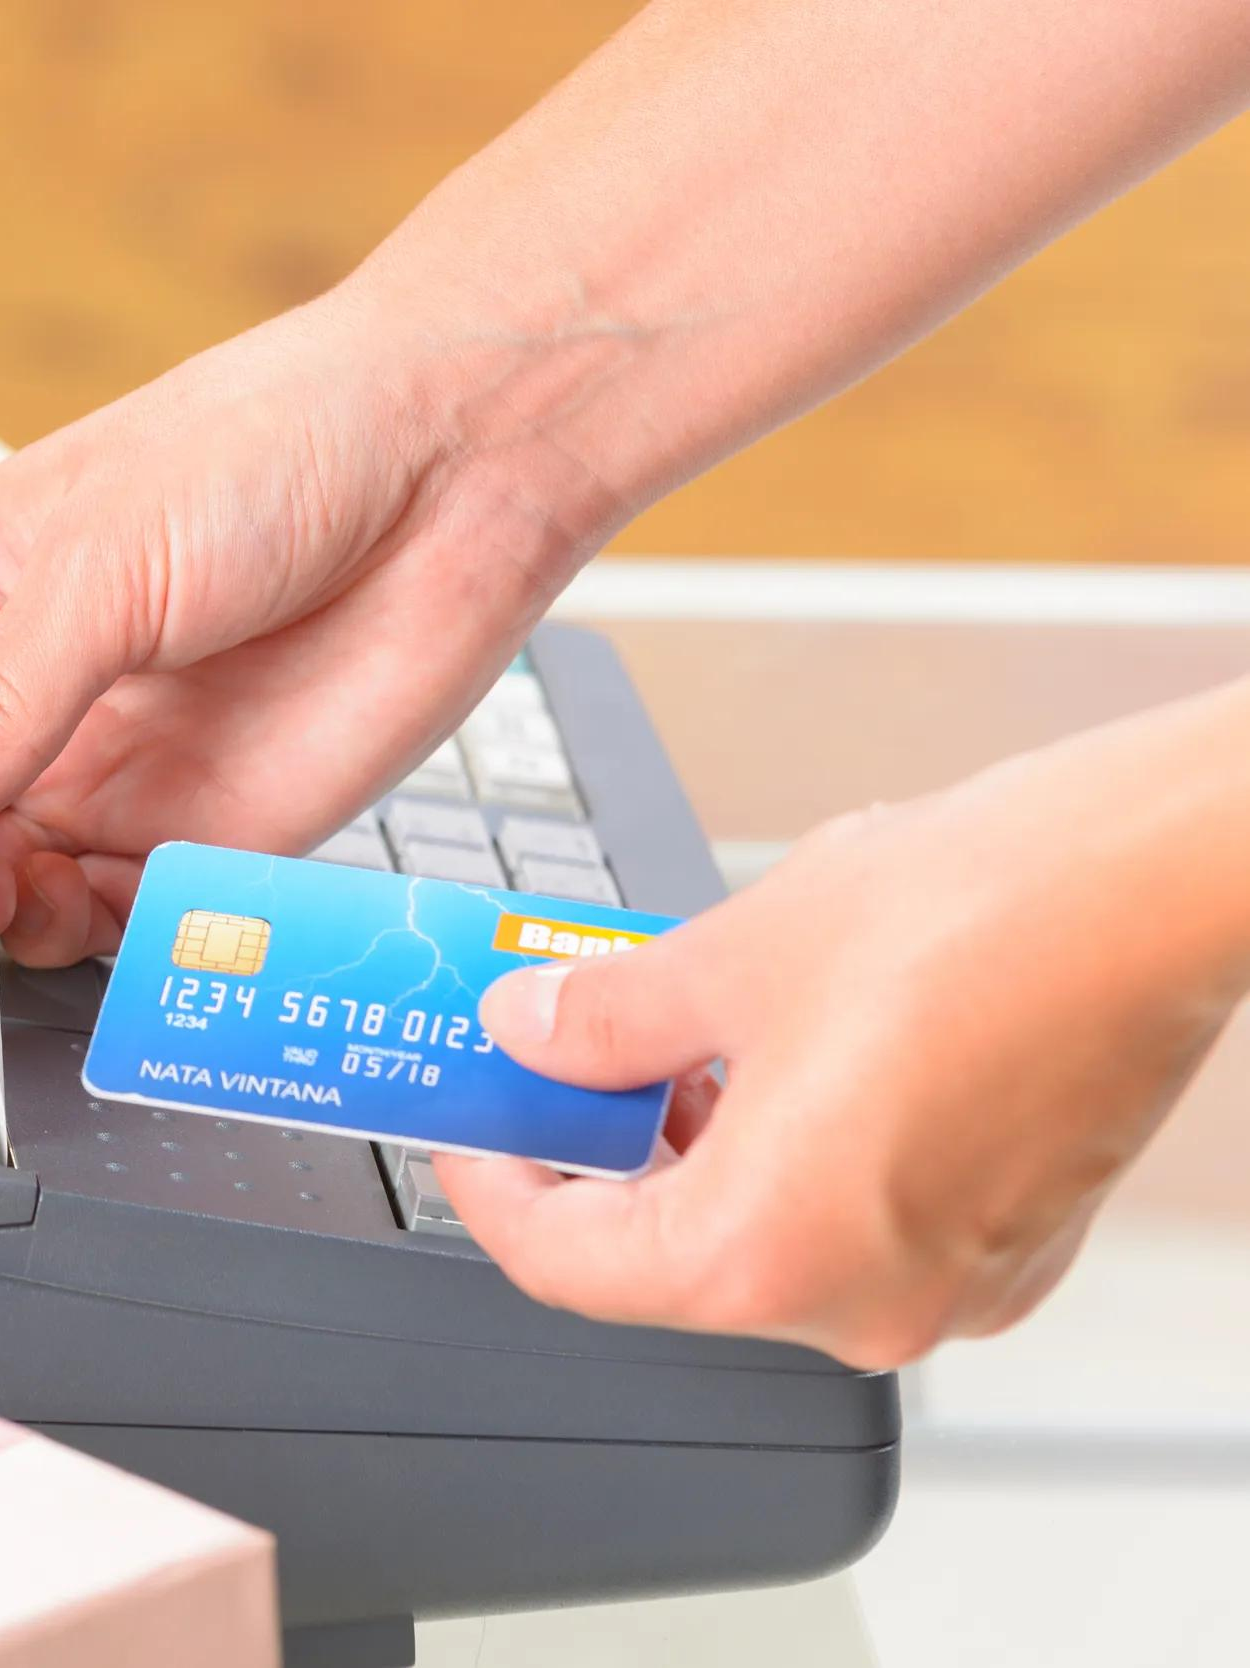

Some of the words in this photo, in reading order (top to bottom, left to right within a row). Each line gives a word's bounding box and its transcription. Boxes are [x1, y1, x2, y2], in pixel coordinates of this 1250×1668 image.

[159, 975, 256, 1019] 1234
[278, 991, 386, 1036] 5678
[402, 1009, 494, 1054] 0123
[165, 1012, 208, 1030] 1234
[140, 1059, 212, 1088] NATA
[220, 1071, 342, 1107] VINTANA
[341, 1052, 441, 1087] 05/18
